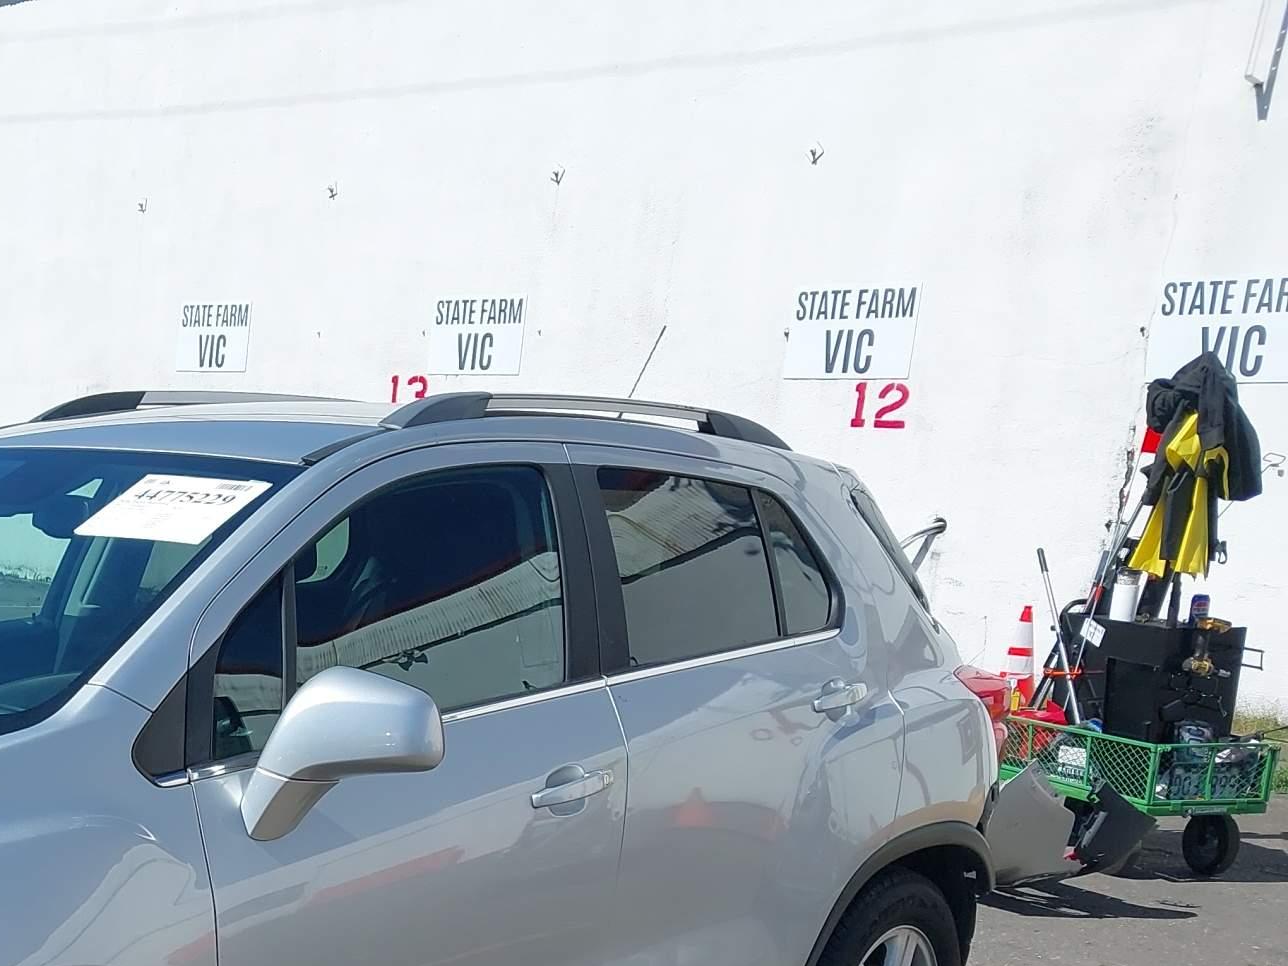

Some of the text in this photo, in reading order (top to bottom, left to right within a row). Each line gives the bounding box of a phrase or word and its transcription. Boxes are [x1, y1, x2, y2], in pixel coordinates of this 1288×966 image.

[182, 303, 249, 328] STATE FARM
[435, 298, 524, 325] STATE FARM
[796, 286, 918, 321] STATE FARM
[1161, 280, 1238, 316] STATE
[199, 334, 227, 368] VIC
[457, 332, 494, 371] VIC
[824, 328, 875, 375] VIC
[850, 381, 910, 429] 12
[134, 488, 237, 506] 44775229
